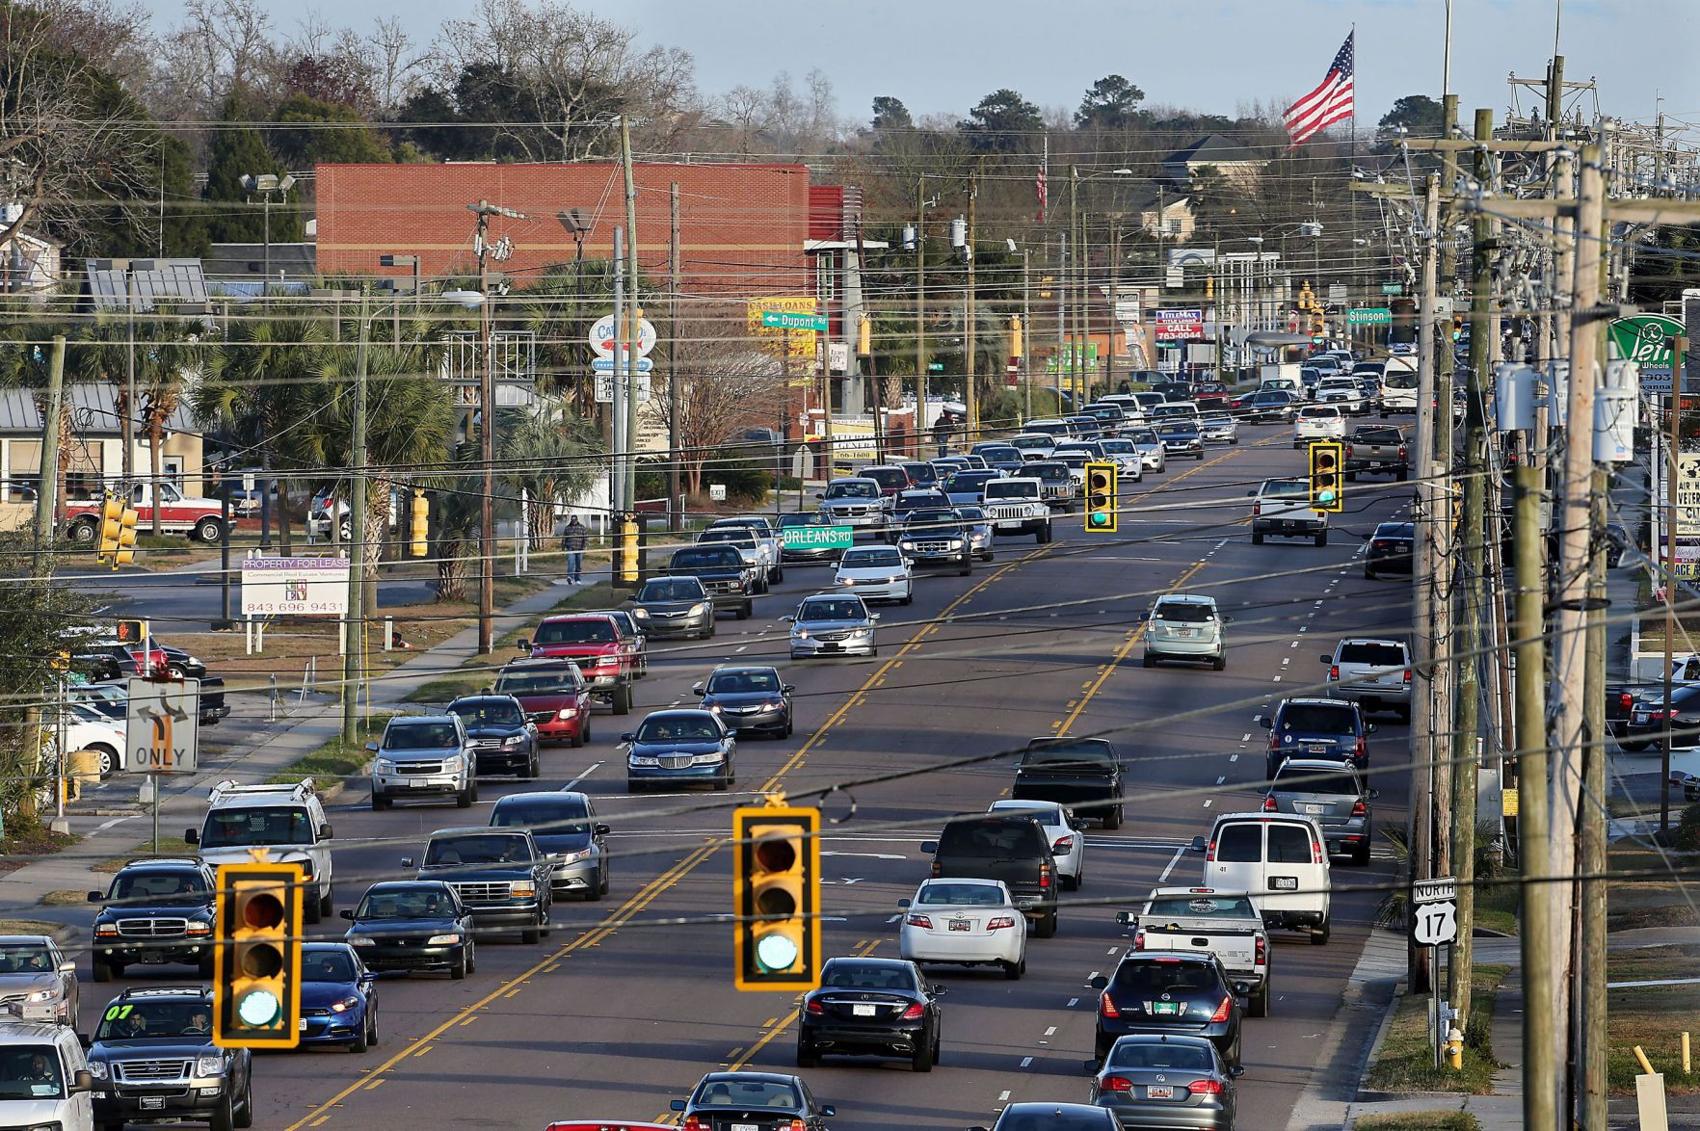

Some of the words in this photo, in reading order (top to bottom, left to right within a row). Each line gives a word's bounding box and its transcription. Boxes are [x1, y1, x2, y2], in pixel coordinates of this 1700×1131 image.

[781, 315, 815, 328] Dupont
[1350, 311, 1384, 321] Stinson
[1167, 324, 1192, 332] CALL
[784, 530, 837, 544] ORLEANS
[838, 531, 851, 542] RD
[243, 559, 294, 569] PROPERTY
[297, 559, 317, 568] FOR
[320, 559, 350, 568] LEASE
[247, 603, 273, 612] 843
[279, 603, 305, 612] 696
[310, 603, 344, 612] 9431
[136, 747, 186, 766] ONLY
[1416, 881, 1454, 898] NORTH
[1425, 912, 1446, 938] 17
[105, 1004, 134, 1021] 07
